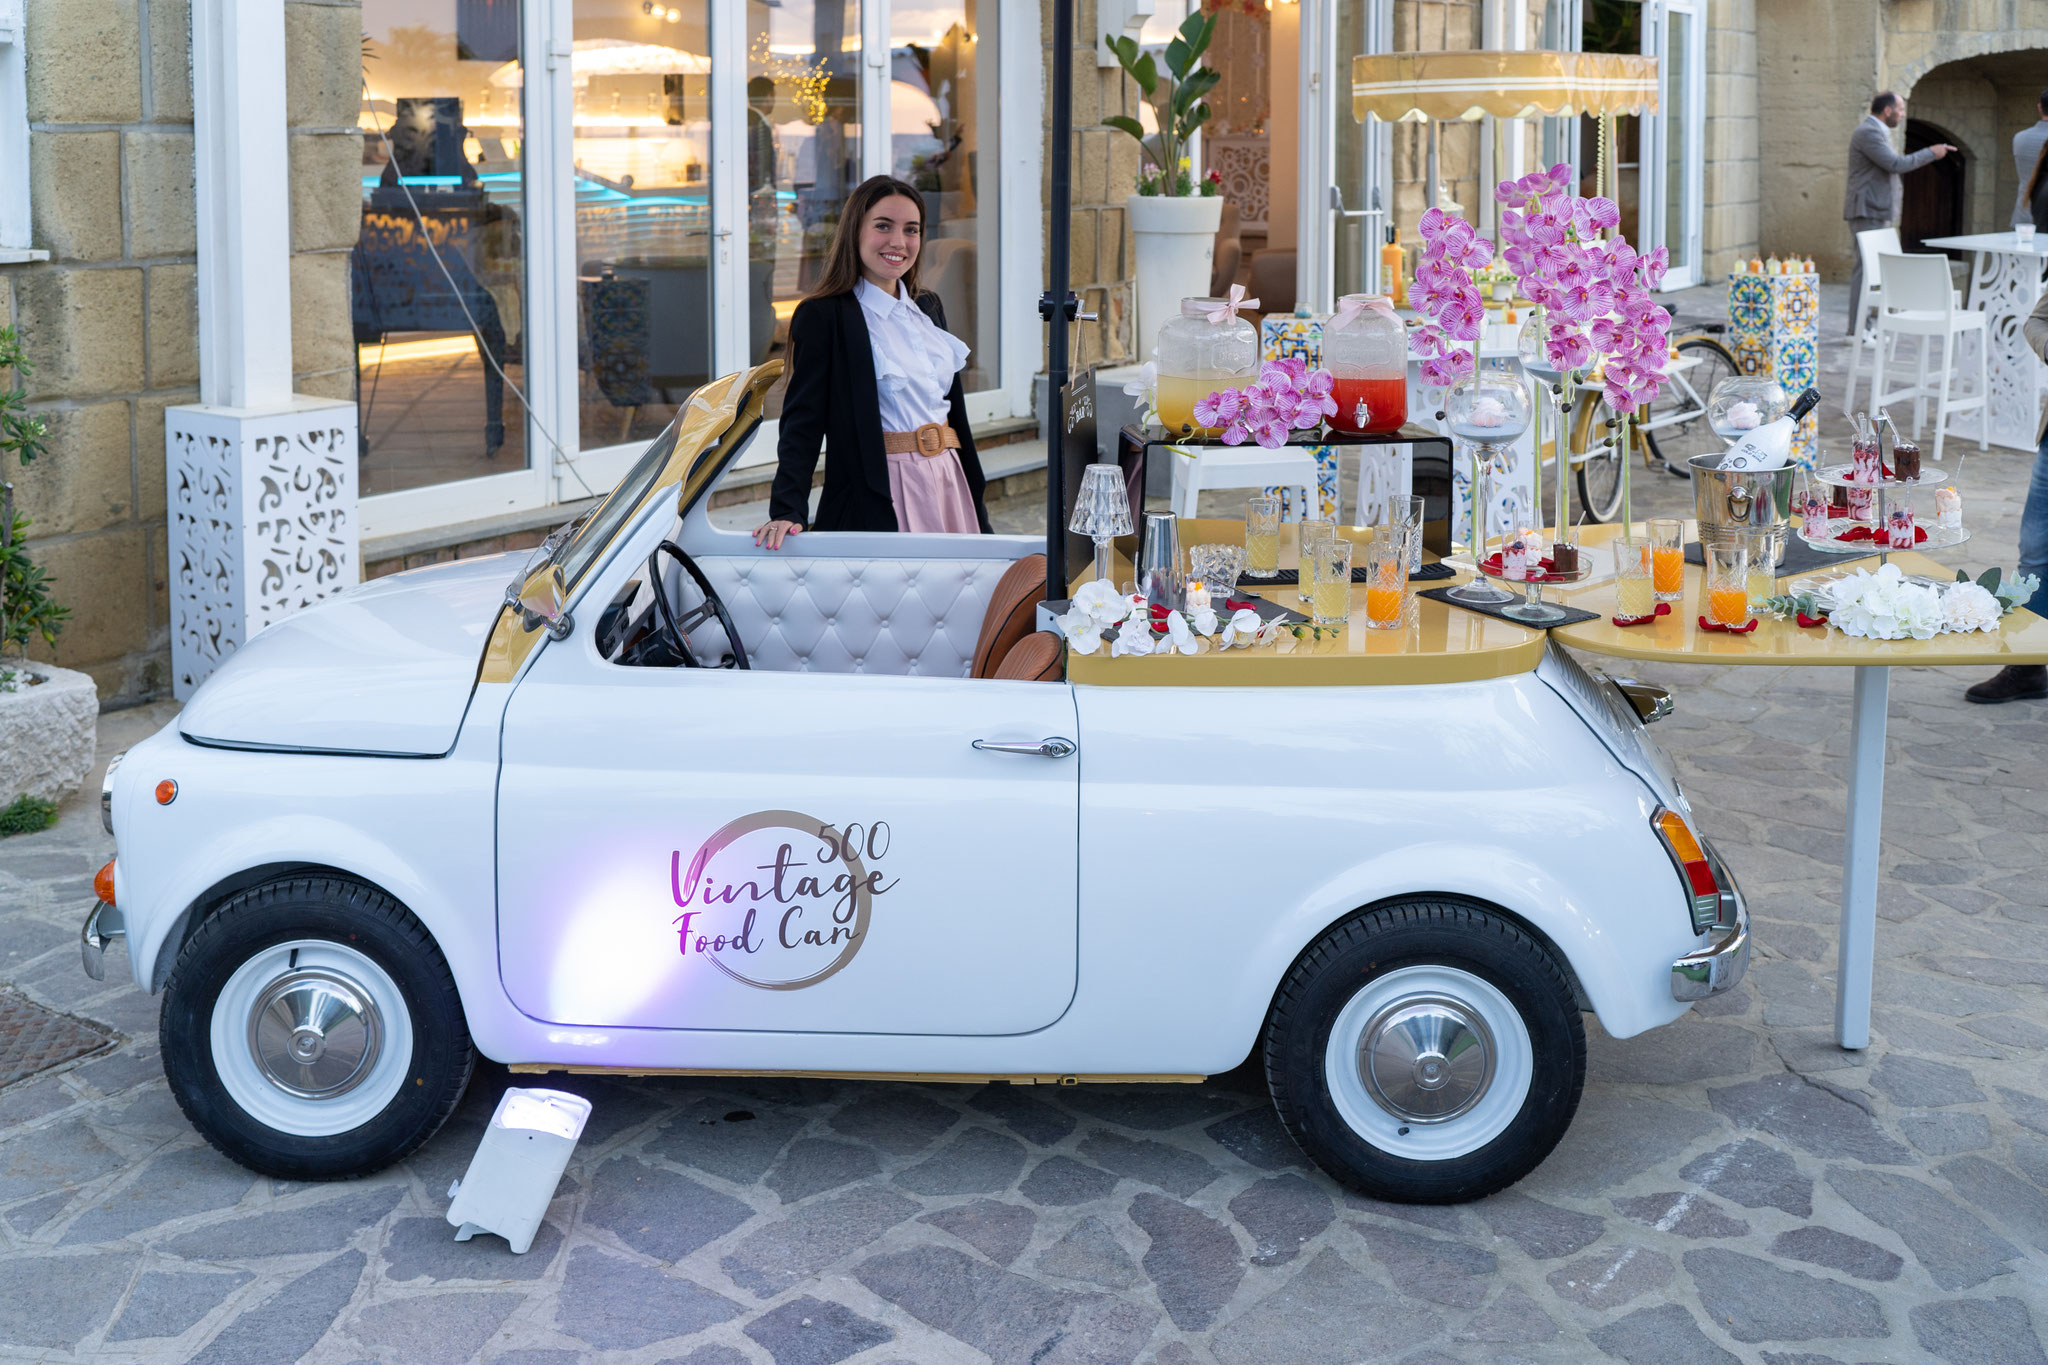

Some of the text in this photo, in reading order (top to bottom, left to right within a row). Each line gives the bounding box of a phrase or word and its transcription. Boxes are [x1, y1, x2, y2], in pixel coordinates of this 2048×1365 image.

[816, 820, 891, 864] 500
[671, 843, 901, 924] Vintage
[672, 905, 861, 956] Food Car
